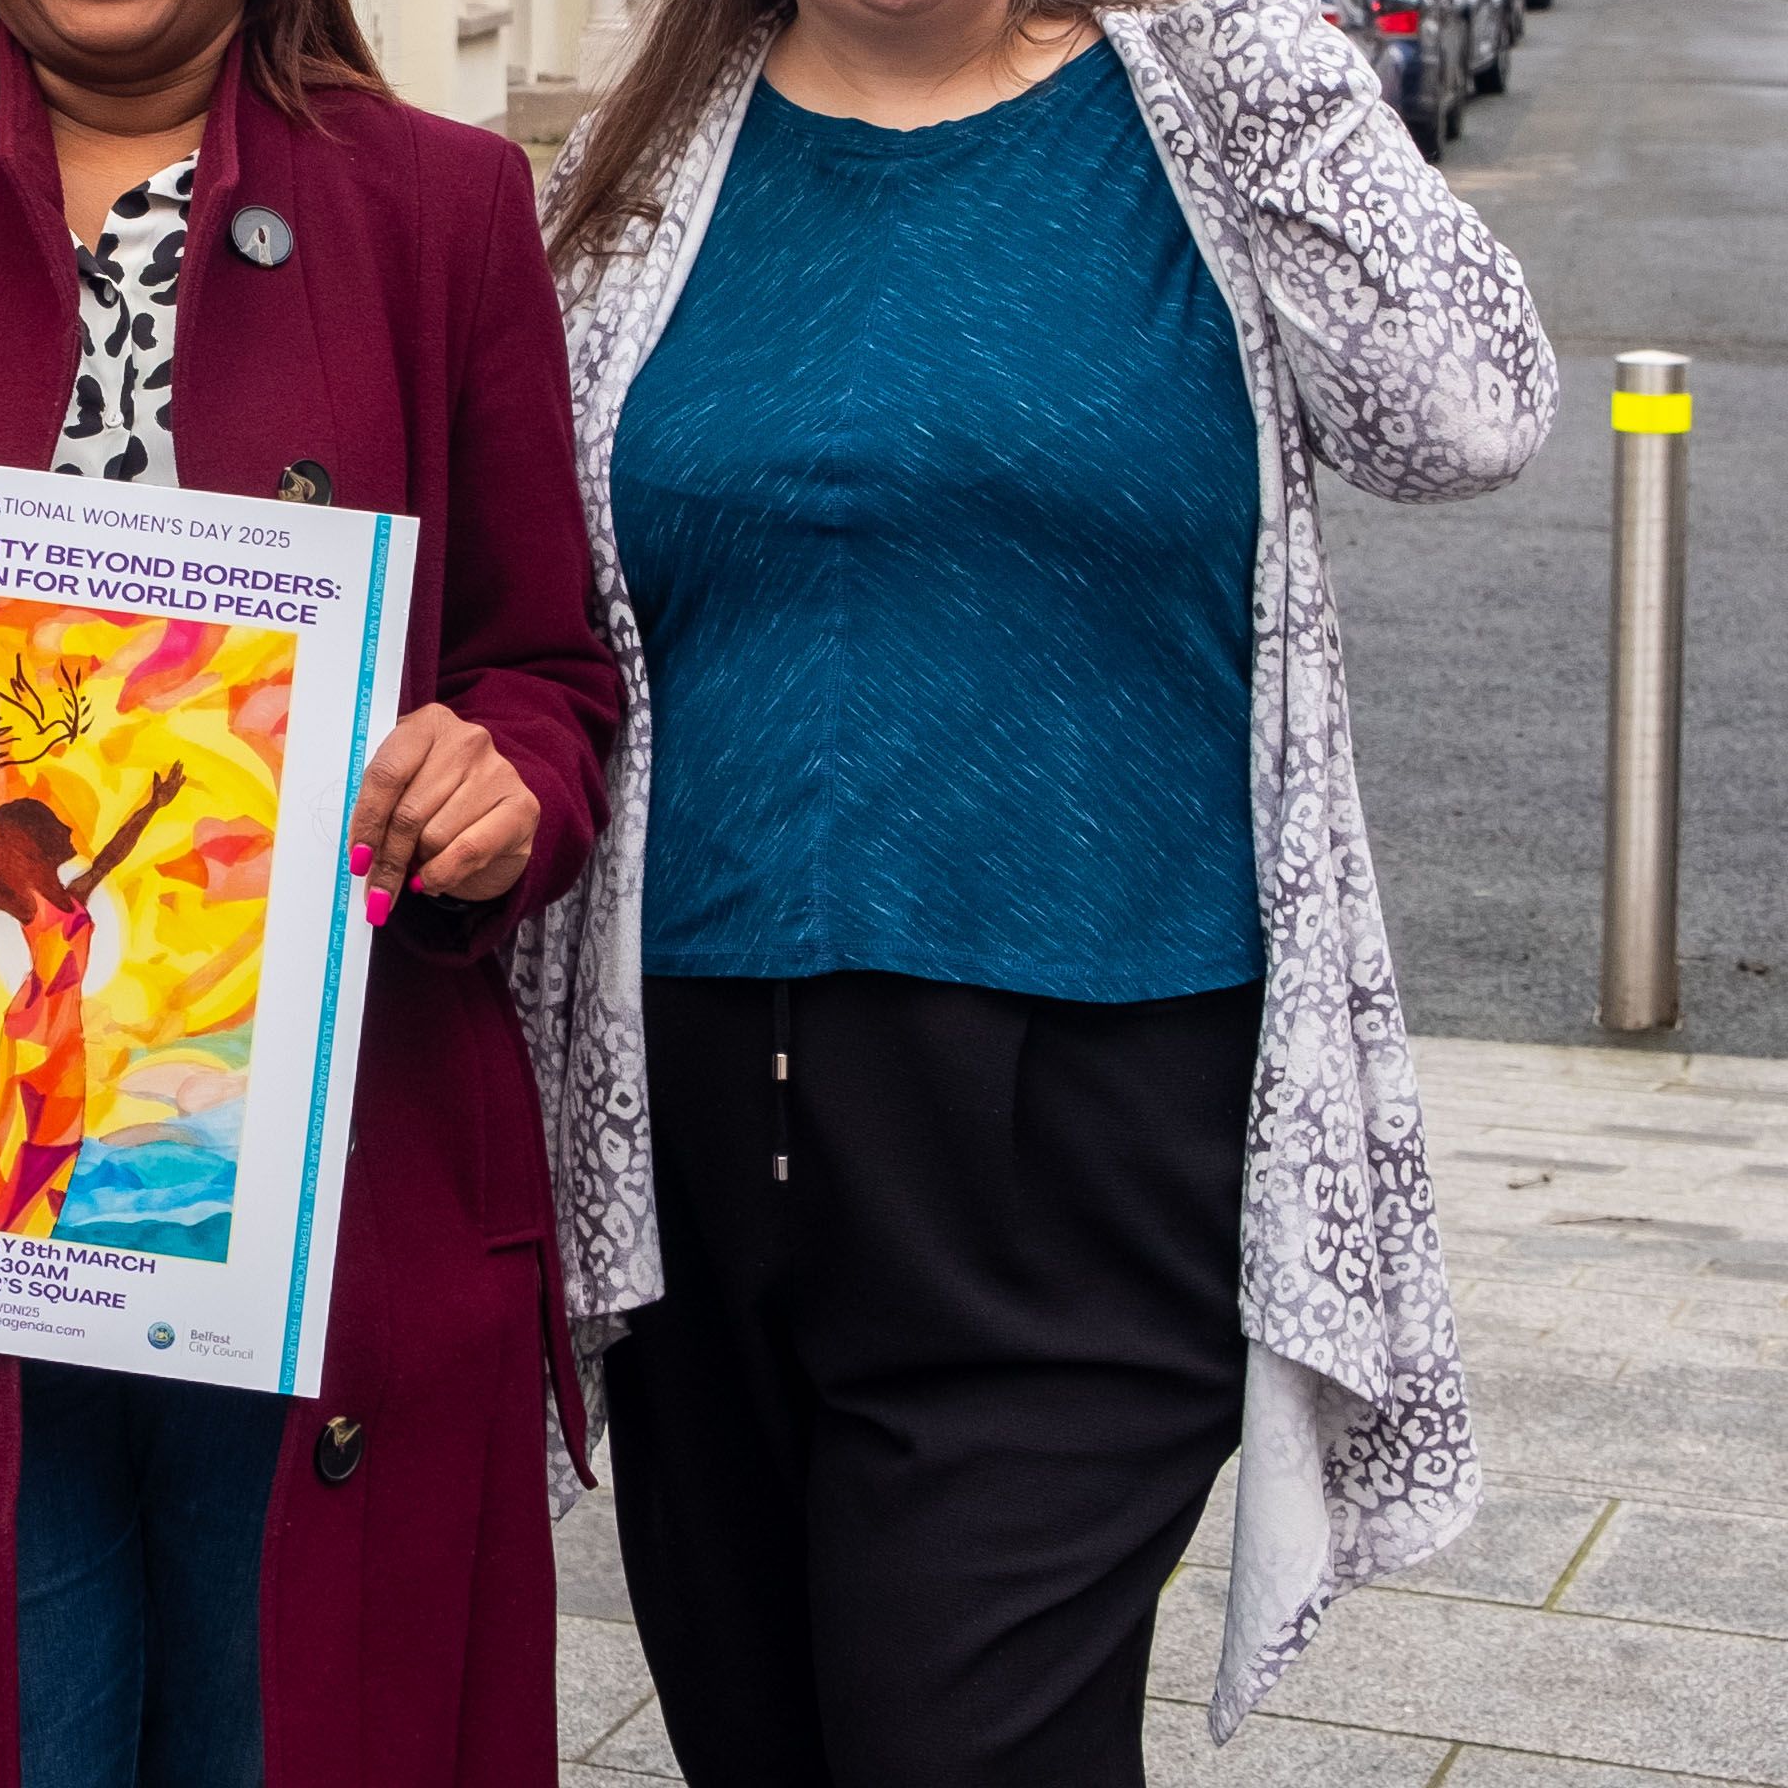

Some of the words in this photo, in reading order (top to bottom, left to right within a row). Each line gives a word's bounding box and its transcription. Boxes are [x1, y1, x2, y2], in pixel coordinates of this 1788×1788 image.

[83, 507, 182, 536] WOMEN'S
[190, 520, 233, 542] DAY
[238, 526, 291, 549] 2025
[45, 545, 175, 578] BEYOND
[181, 561, 342, 600] BORDERS:
[16, 568, 79, 595] FOR
[87, 577, 207, 610] WORLD
[213, 593, 319, 625] PEACE
[367, 619, 378, 635] NA
[363, 638, 376, 671] MBAN
[336, 873, 349, 913] FEMME
[21, 1241, 61, 1261] 8th
[66, 1247, 156, 1274] MARCH
[27, 1281, 127, 1309] SQUARE
[188, 1341, 210, 1357] City
[212, 1344, 253, 1360] Council
[190, 1329, 231, 1345] Belfast
